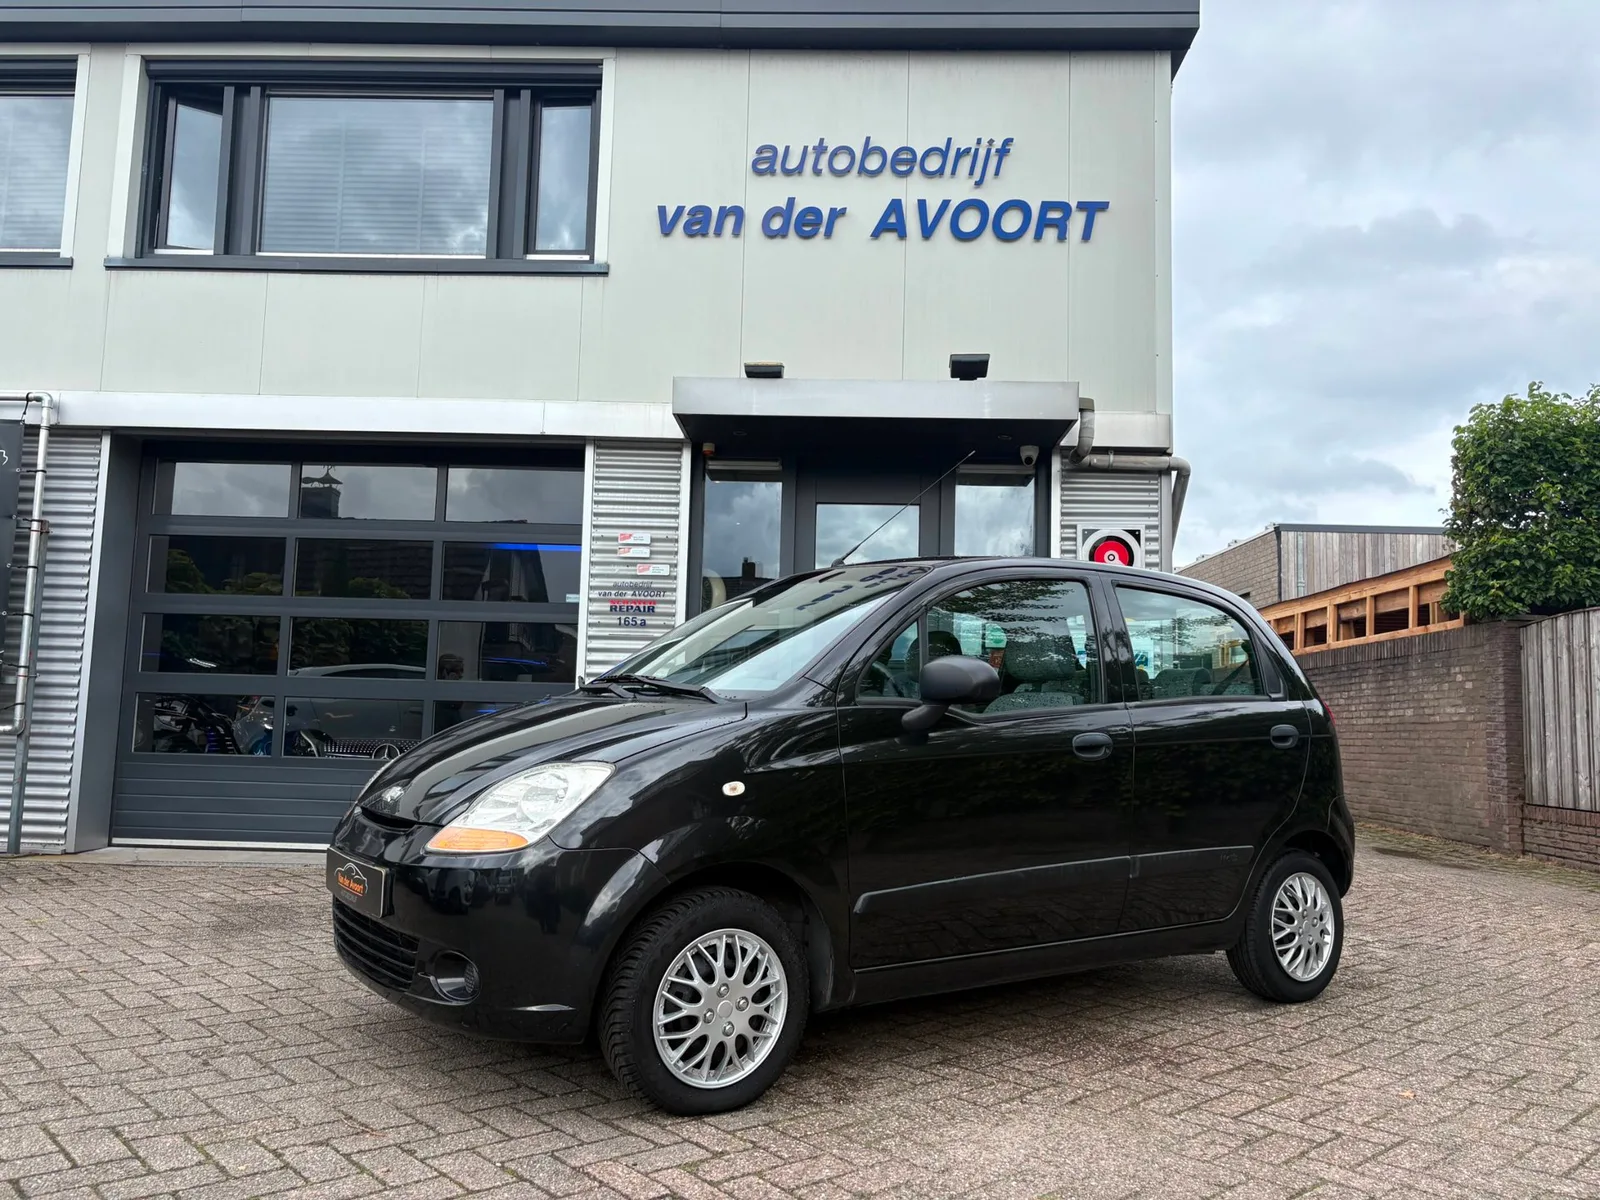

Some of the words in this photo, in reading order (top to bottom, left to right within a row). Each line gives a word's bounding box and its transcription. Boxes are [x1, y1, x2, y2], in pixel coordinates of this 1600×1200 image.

[751, 136, 1015, 187] autobedrijf
[657, 204, 745, 236] van
[761, 196, 848, 238] der
[871, 198, 1111, 241] AVOORT
[612, 581, 653, 589] autobedrijf
[614, 590, 627, 598] der
[631, 590, 667, 598] AVOORT
[609, 605, 655, 613] REPAIR
